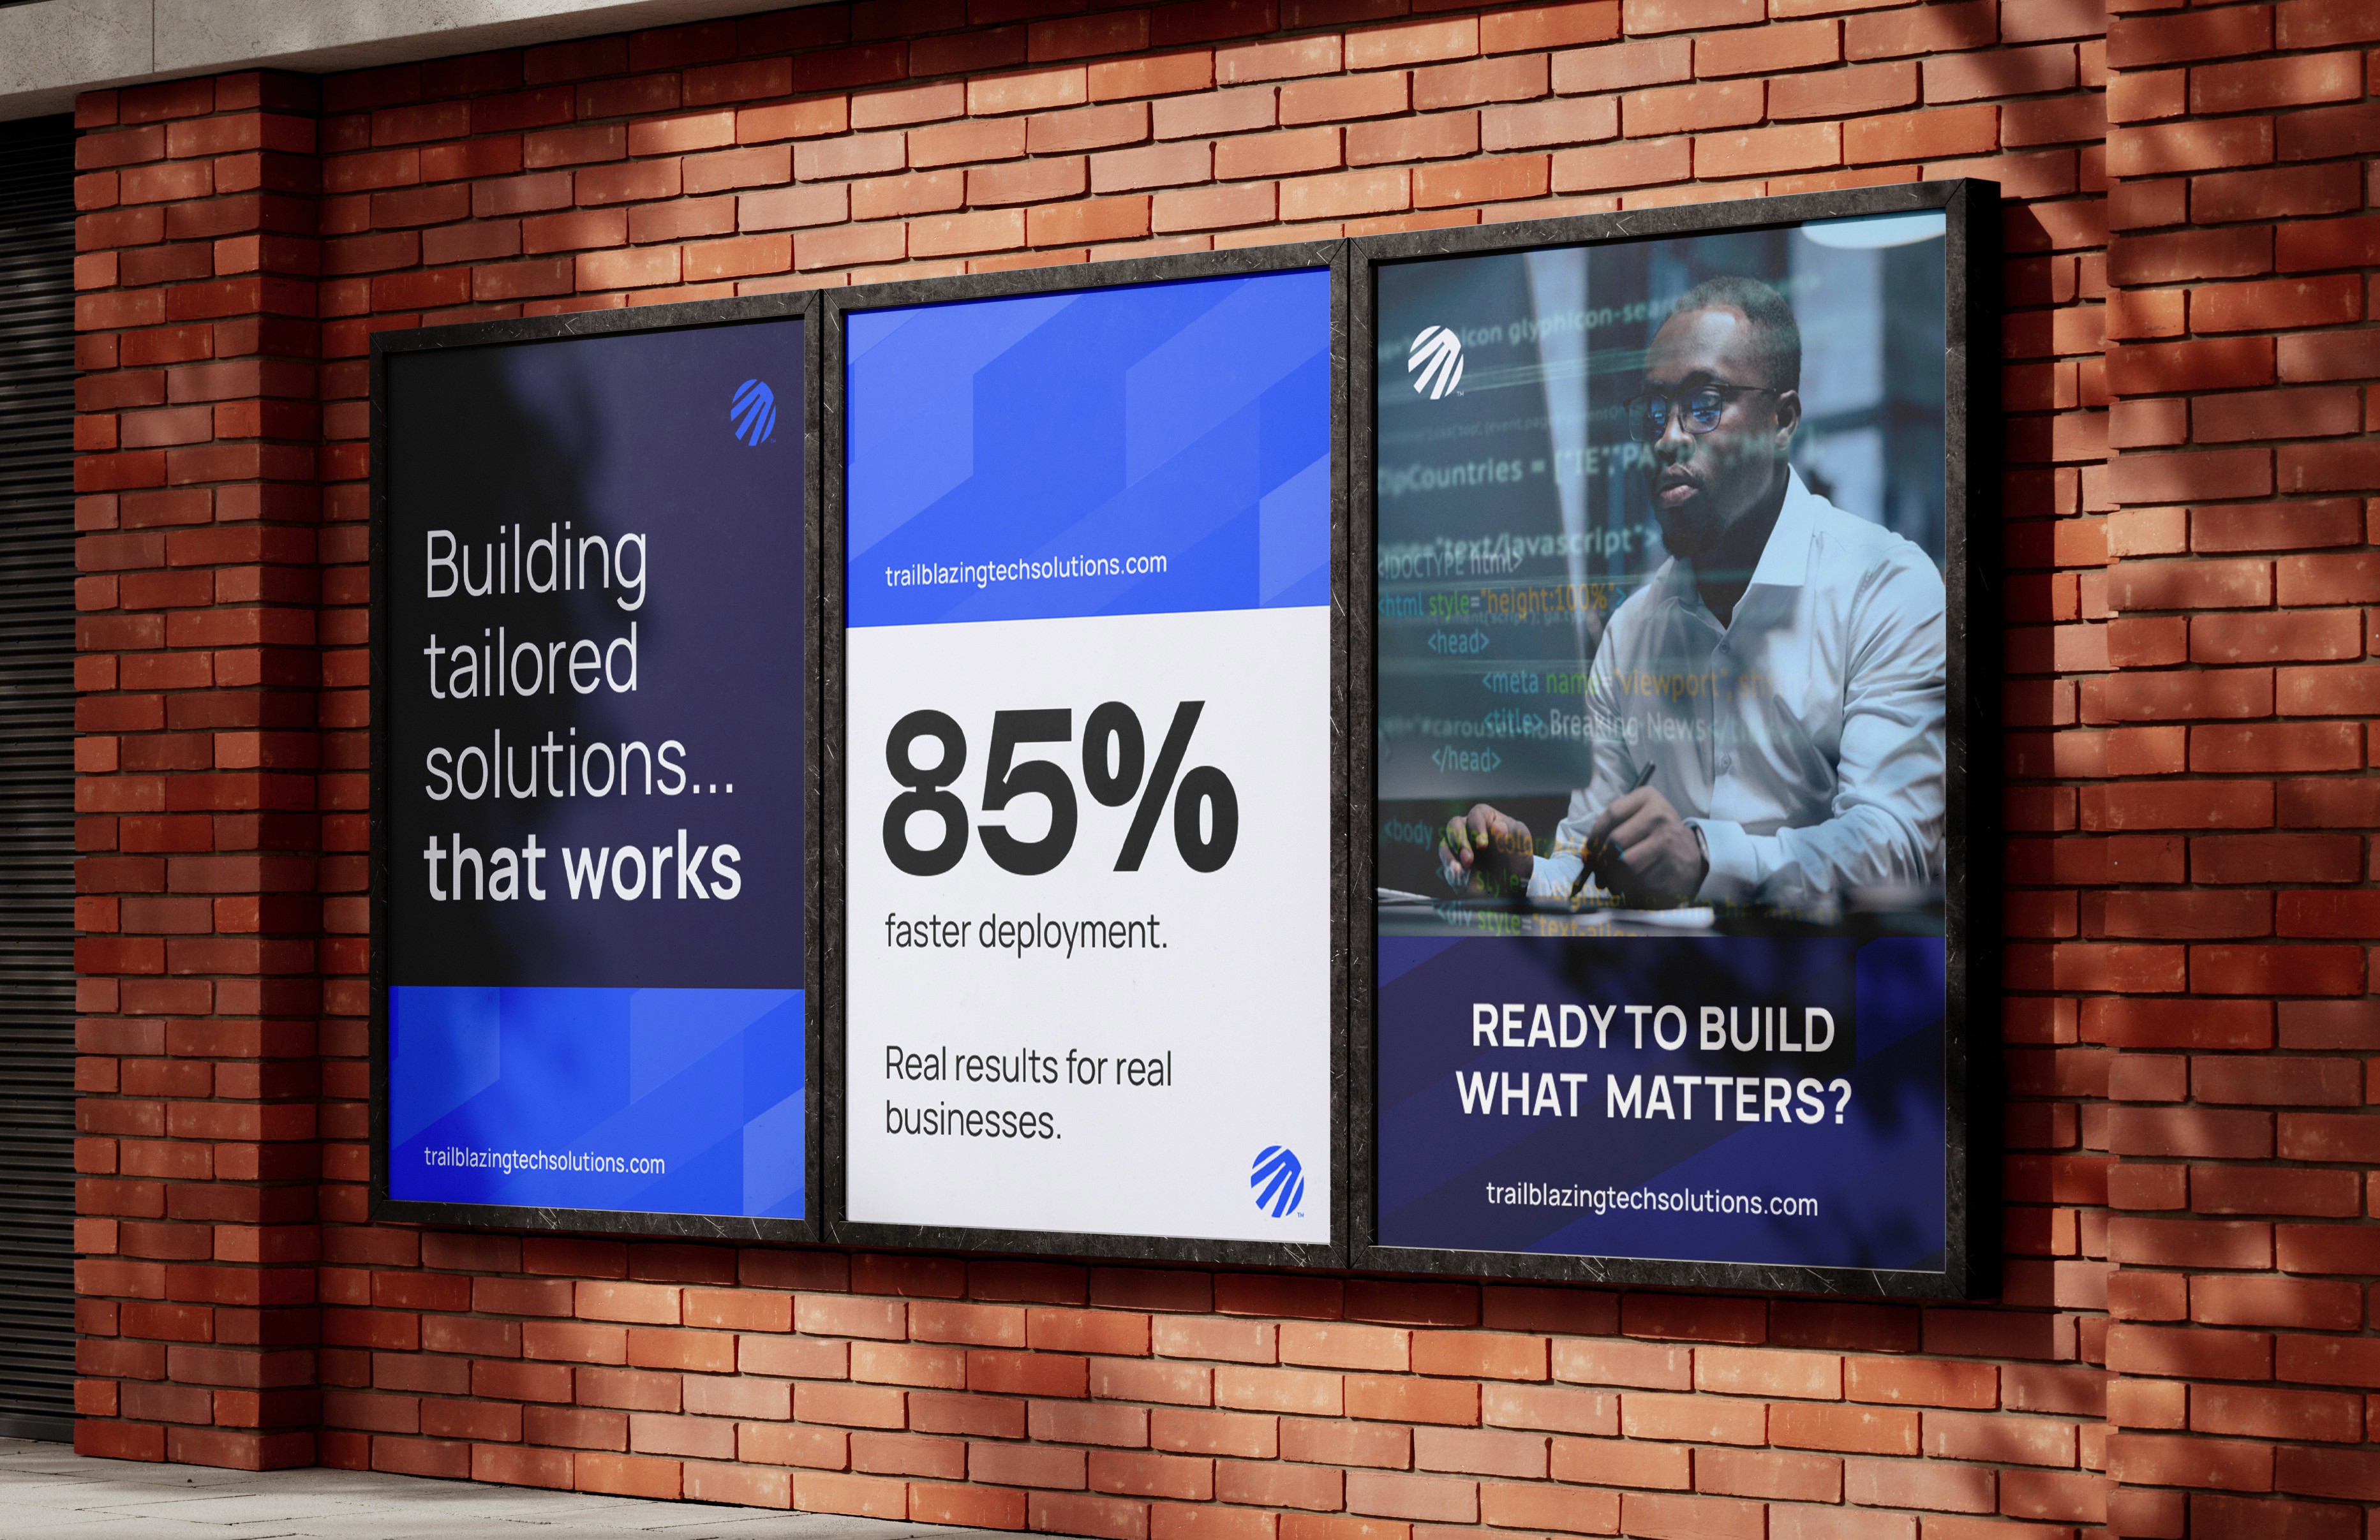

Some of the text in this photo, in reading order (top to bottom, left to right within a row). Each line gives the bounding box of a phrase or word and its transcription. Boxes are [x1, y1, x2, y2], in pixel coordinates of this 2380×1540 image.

[427, 521, 646, 611] Building
[885, 553, 1167, 588] trailblazingtechsolutions.com
[424, 621, 637, 699] tailored
[1427, 629, 1490, 654] <head>
[1482, 670, 1539, 693] <meta
[1550, 709, 1639, 743] Breaking
[425, 727, 733, 800] solutions...
[1432, 744, 1501, 773] </head>
[882, 700, 1238, 877] 85%
[424, 829, 741, 901] that works
[885, 913, 1168, 959] faster deployment.
[1473, 1003, 1835, 1052] READY TO BUILD
[886, 1046, 1172, 1086] Real results for real
[1456, 1070, 1852, 1124] WHAT MATTERS?
[886, 1100, 1062, 1139] businesses.
[424, 1146, 666, 1175] trailblazingtechsolutions.com
[1486, 1181, 1818, 1216] trailblazingtechsolutions.com
